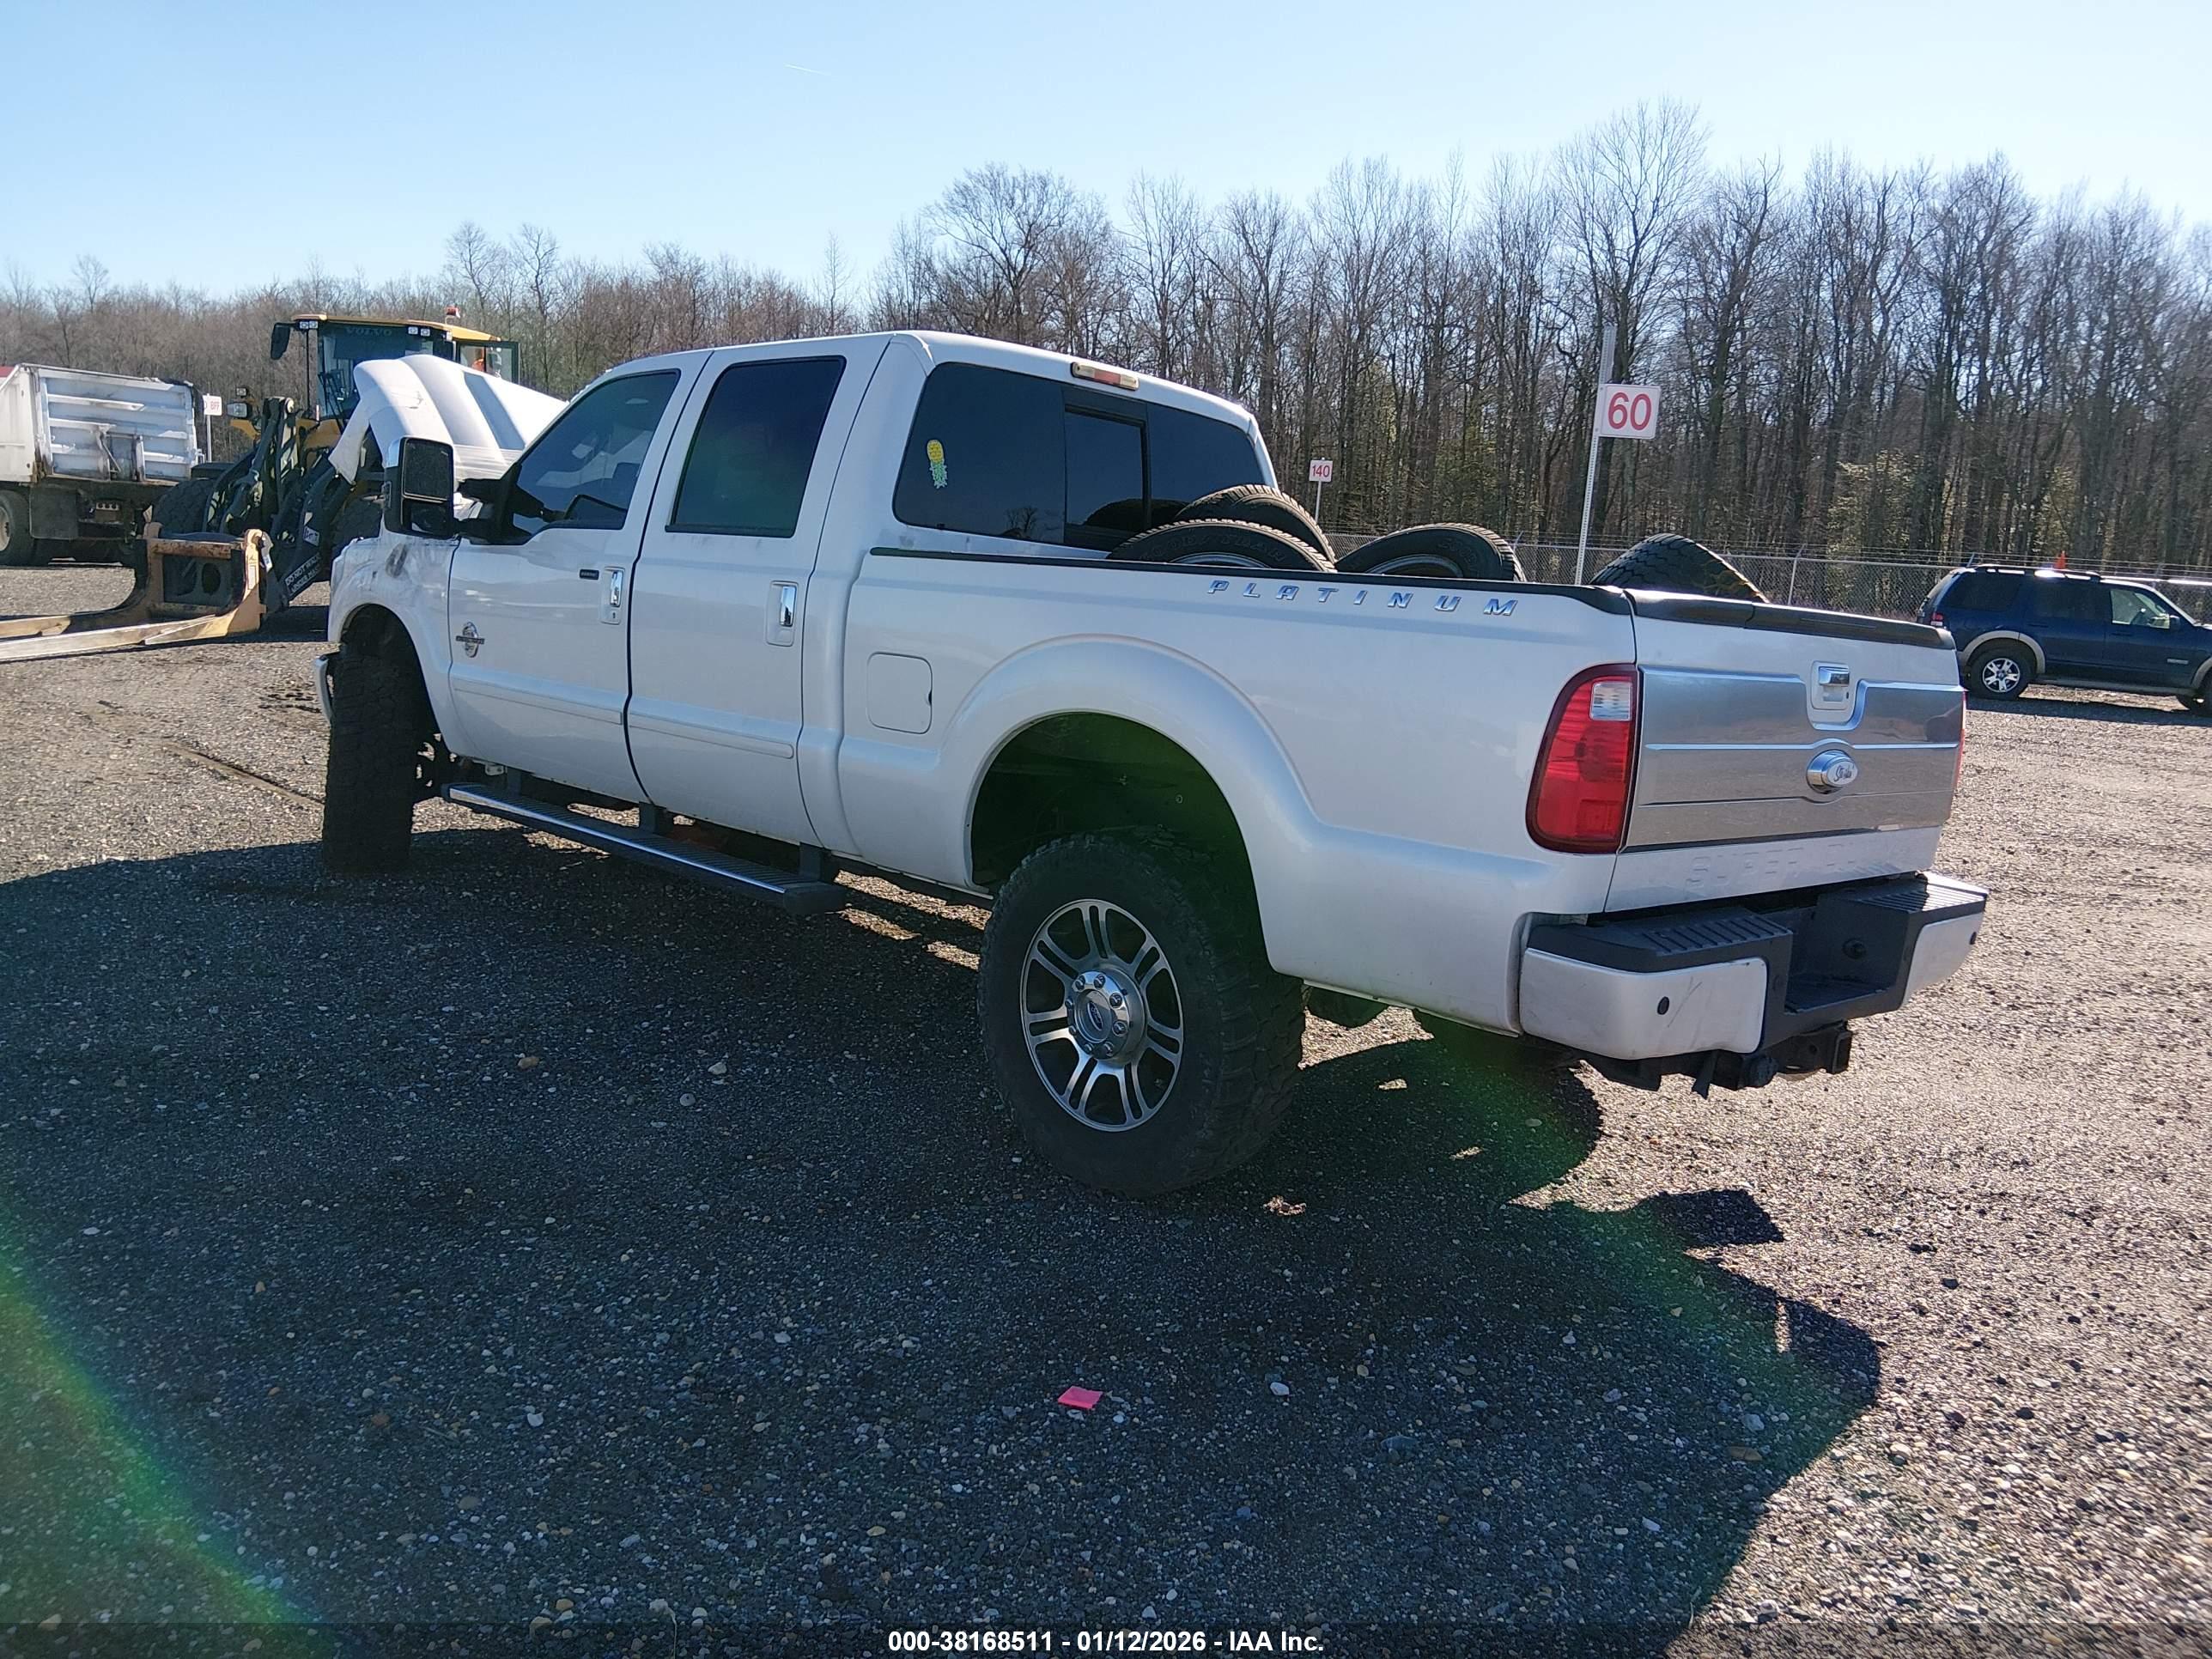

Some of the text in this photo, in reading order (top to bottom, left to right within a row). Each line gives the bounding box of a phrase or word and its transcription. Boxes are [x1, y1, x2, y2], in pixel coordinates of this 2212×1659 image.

[1607, 392, 1652, 431] 60
[1312, 465, 1330, 477] 140
[1206, 579, 1519, 617] PLATINUM
